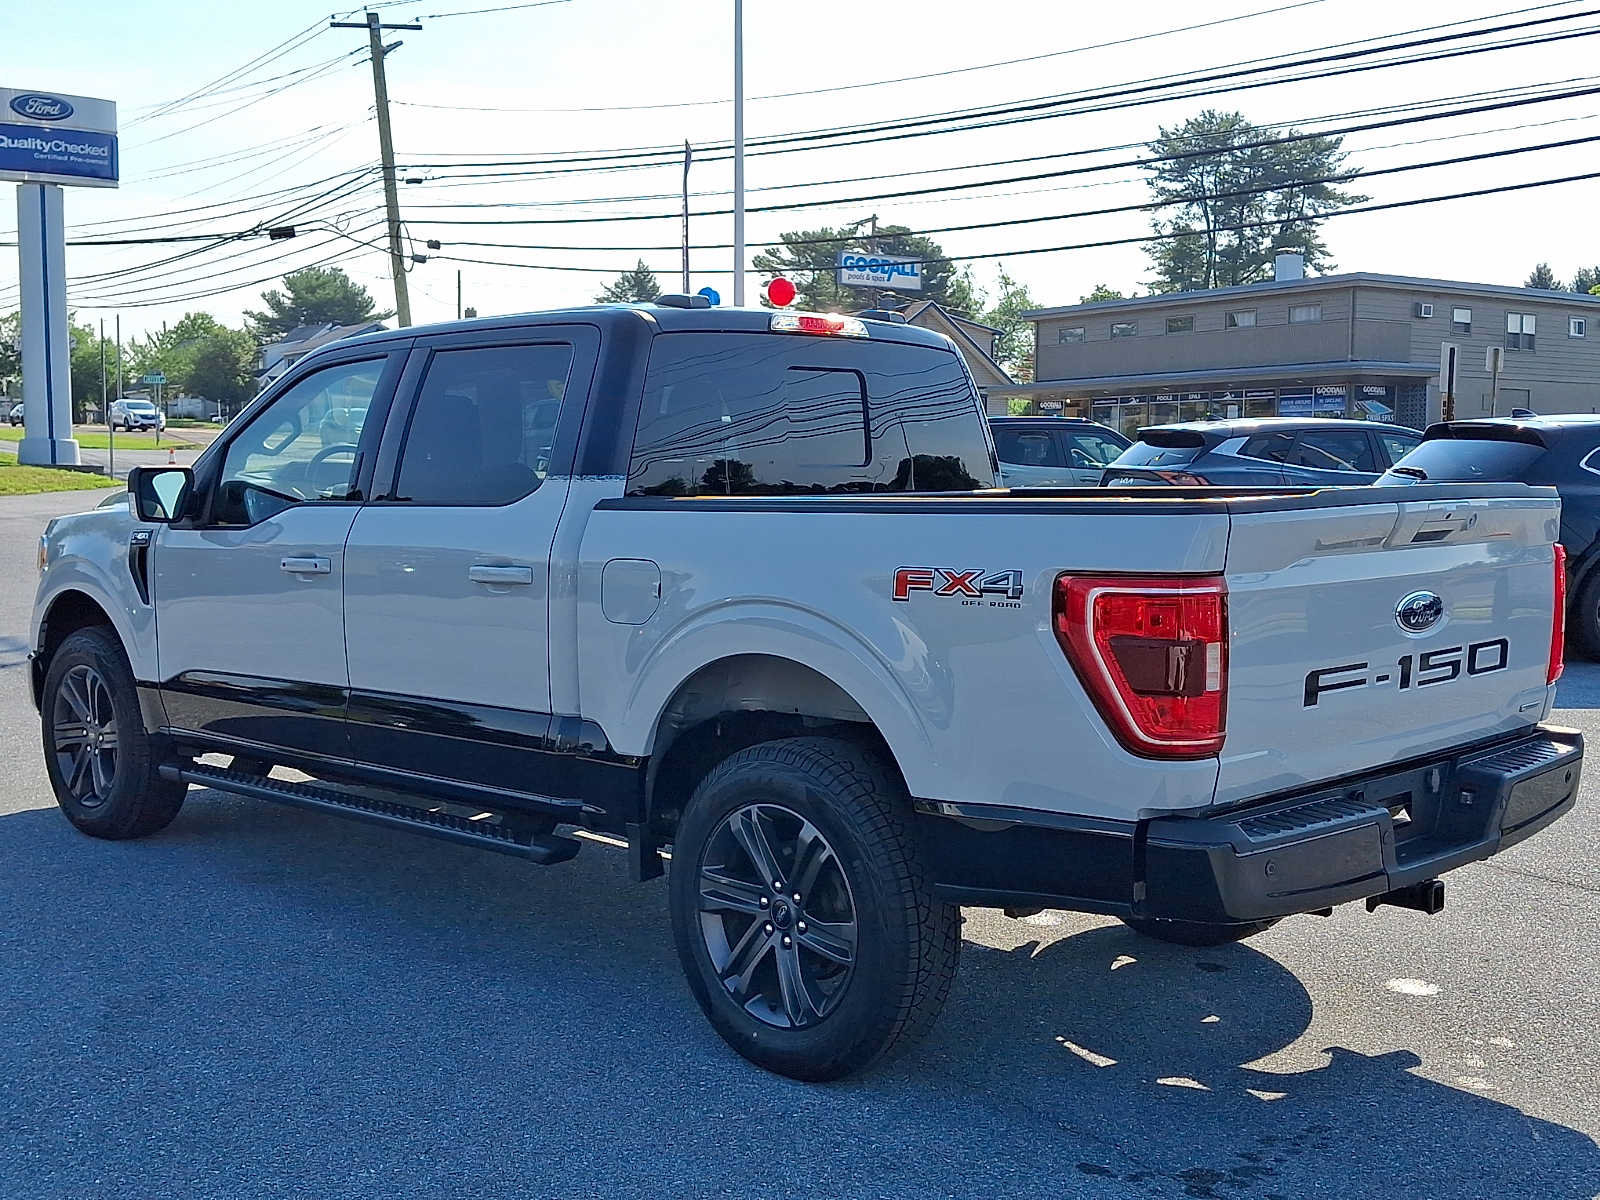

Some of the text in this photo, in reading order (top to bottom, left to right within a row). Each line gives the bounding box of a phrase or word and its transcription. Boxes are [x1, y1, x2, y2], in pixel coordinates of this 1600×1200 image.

[25, 97, 61, 115] Ford
[0, 135, 108, 157] QualityChecked
[843, 256, 919, 281] GOODALL
[1316, 386, 1346, 395] GOODALL
[892, 566, 1023, 601] FX4
[1302, 637, 1511, 708] F-150
